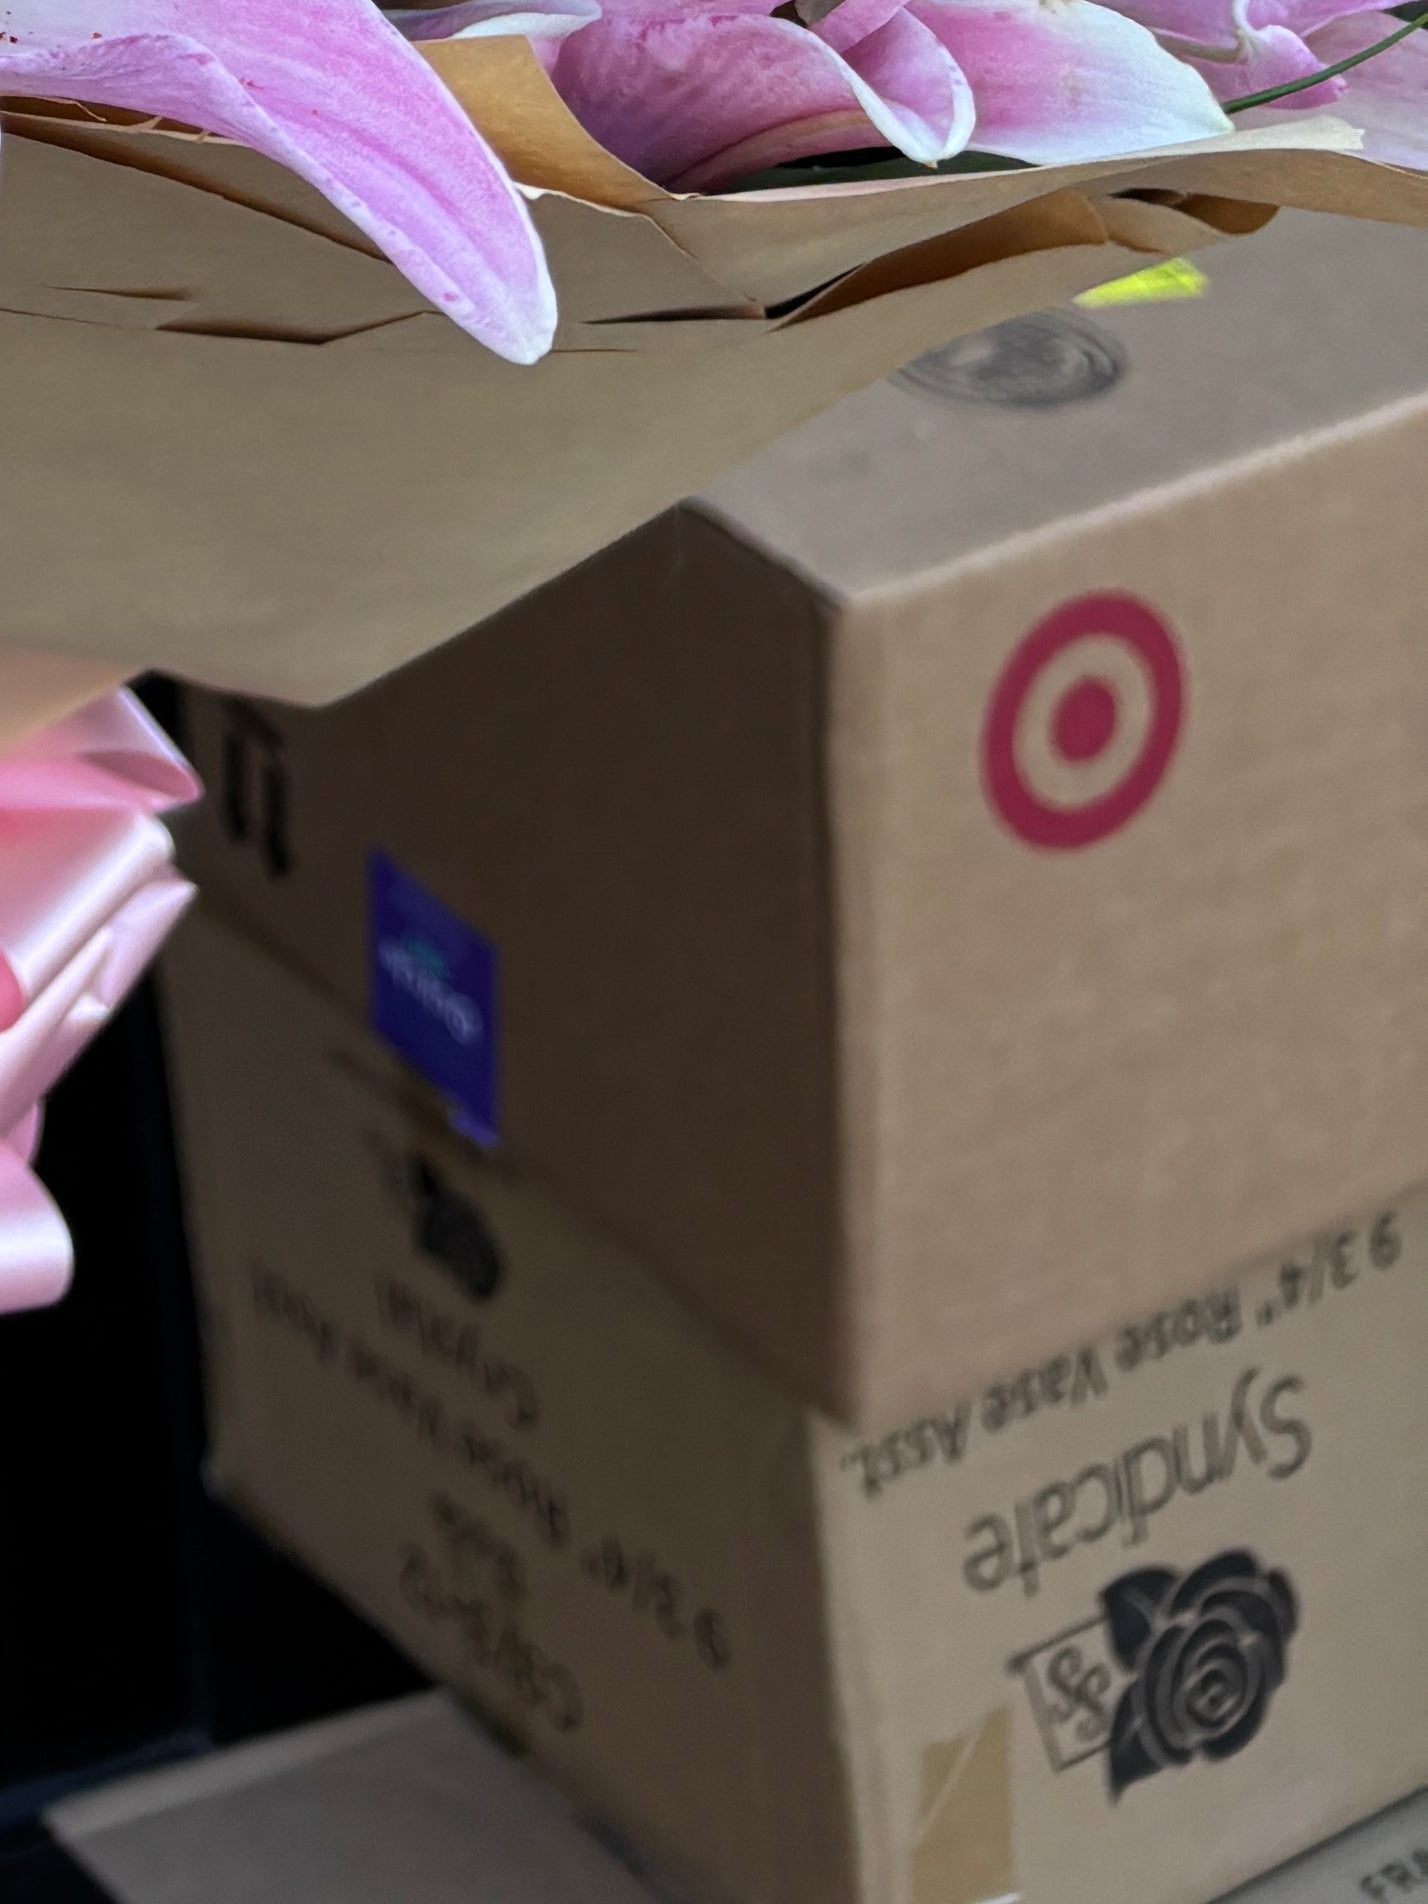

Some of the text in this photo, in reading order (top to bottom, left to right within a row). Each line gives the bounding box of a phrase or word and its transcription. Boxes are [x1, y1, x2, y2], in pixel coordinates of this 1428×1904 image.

[1366, 1209, 1404, 1272] 9
[1113, 1286, 1244, 1373] Rose
[980, 1344, 1110, 1434] Vase
[962, 1365, 1313, 1598] Syndicate
